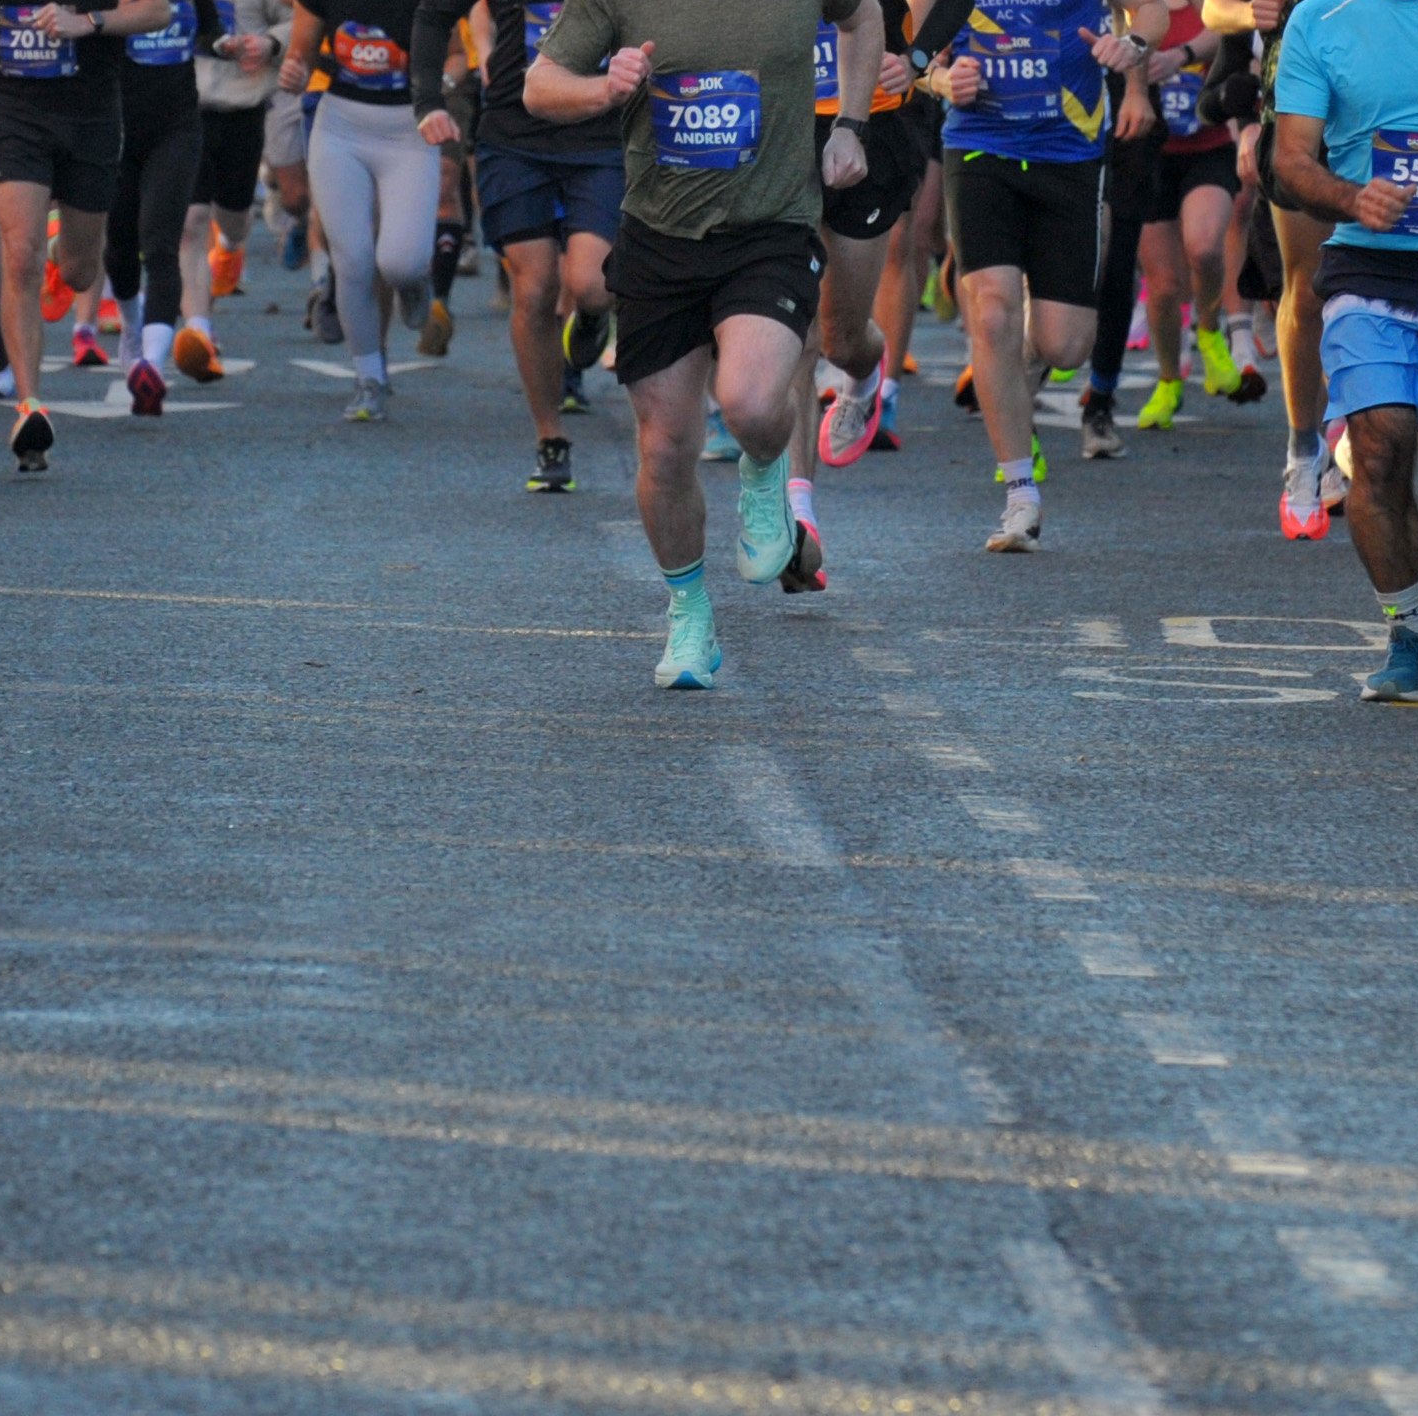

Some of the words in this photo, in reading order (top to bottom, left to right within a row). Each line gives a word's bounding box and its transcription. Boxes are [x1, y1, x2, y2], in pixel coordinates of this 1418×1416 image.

[996, 9, 1014, 20] AC
[1012, 37, 1031, 47] 10K
[13, 49, 58, 60] BUBBLES
[985, 58, 1049, 79] 11183
[698, 77, 723, 90] 10K
[668, 104, 741, 129] 7089
[674, 132, 738, 144] ANDREW
